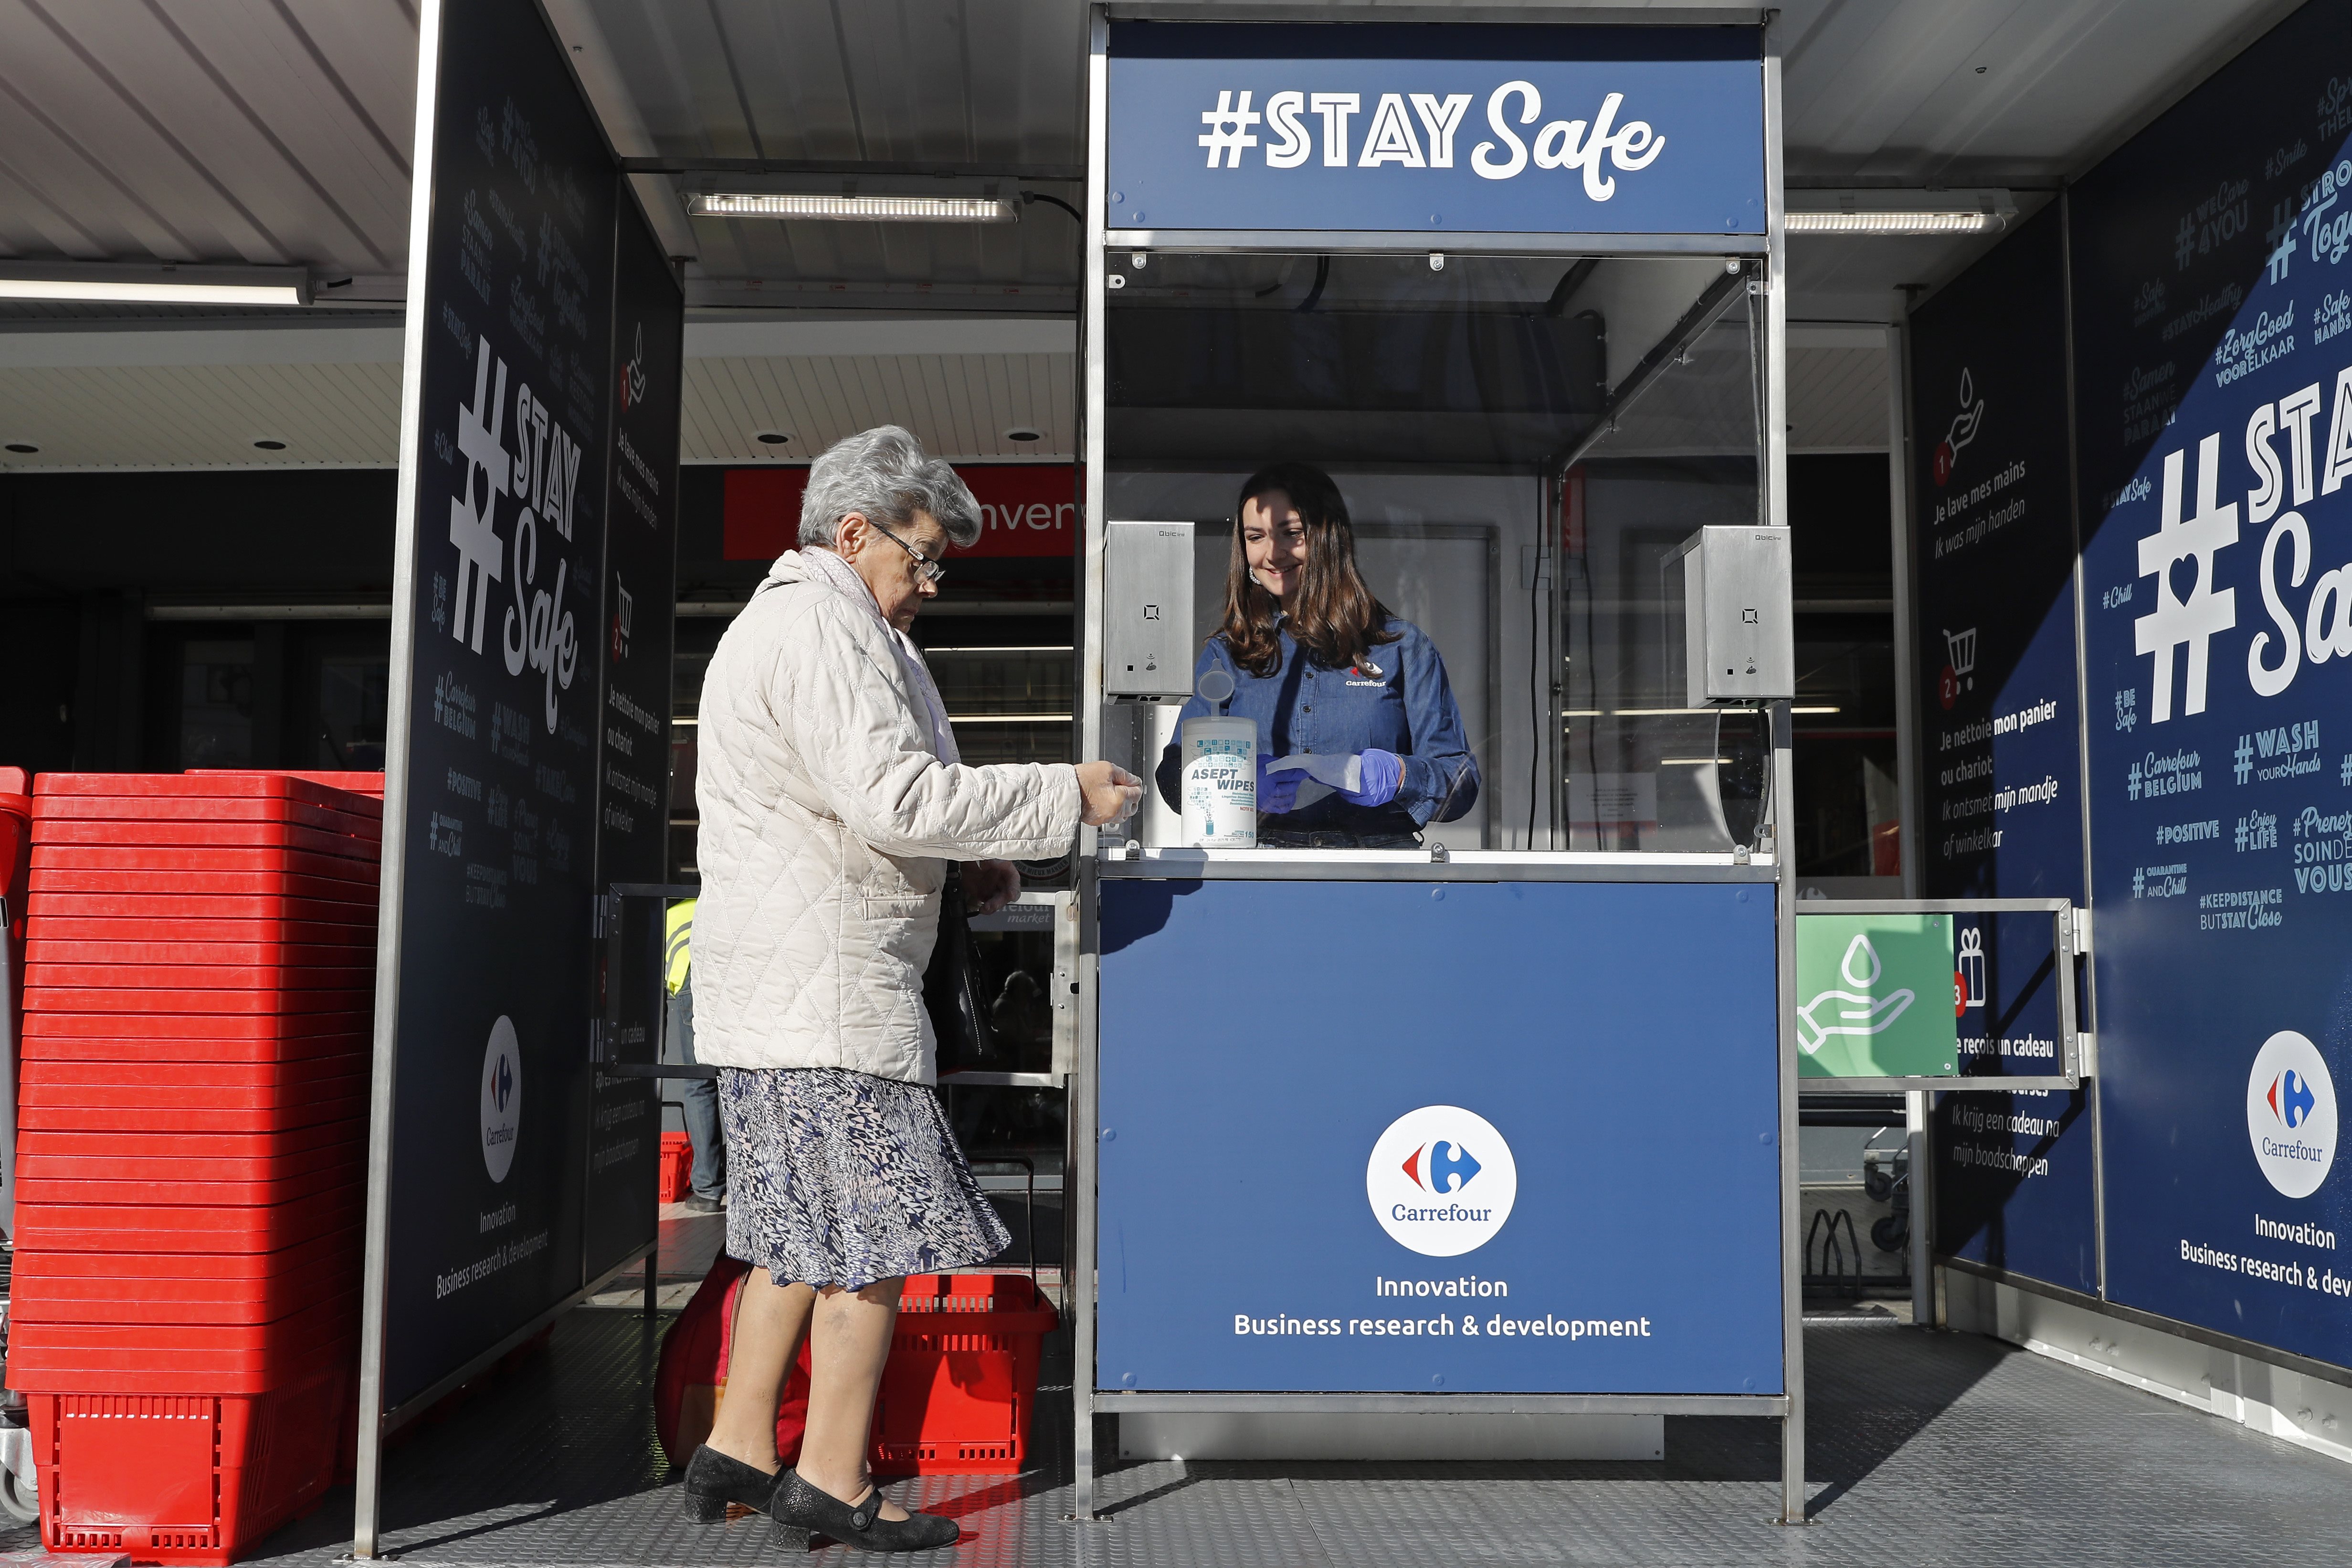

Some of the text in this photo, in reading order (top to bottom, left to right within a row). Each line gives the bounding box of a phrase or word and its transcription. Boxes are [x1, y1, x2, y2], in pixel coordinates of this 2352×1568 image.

[2198, 199, 2247, 254] 4YOU
[2303, 192, 2352, 265] Tog
[2314, 289, 2351, 325] #Safe
[2314, 312, 2352, 346] HANDS
[2215, 335, 2295, 388] VOORELKAAR
[1939, 455, 1944, 474] 1
[1934, 460, 2025, 526] Je lave mes mains
[1935, 498, 2025, 560] Ik was mijn handen
[2103, 583, 2132, 609] #Chill
[2247, 511, 2352, 696] Sa
[504, 507, 578, 734] Safe
[1945, 679, 1951, 699] 2
[2115, 688, 2136, 710] #BE
[444, 705, 476, 740] BELGIUM
[1940, 698, 2057, 752] Je nettoie mon panier
[2116, 707, 2137, 733] Safe
[607, 728, 614, 745] ou
[1192, 768, 1238, 780] ASEPT
[1217, 779, 1255, 792] WIPES
[1941, 755, 1993, 787] ou chariot
[2144, 771, 2202, 798] BELGIUM
[1942, 775, 2058, 821] Ik ontsmet mijn mandje
[1944, 826, 2003, 860] of winkelkar
[2156, 820, 2220, 845] #POSITIVE
[2250, 830, 2278, 850] LIFE
[2294, 863, 2352, 894] VOUS
[2200, 889, 2283, 909] #KEEPDISTANCE
[1007, 913, 1050, 924] market
[1957, 1033, 2054, 1060] e reçois un cadeau
[486, 1123, 514, 1147] Carrefour
[1952, 1104, 2059, 1137] Ik krijg een cadeau na
[1953, 1142, 2048, 1178] mijn boodschappen
[2262, 1137, 2323, 1163] Carrefour
[480, 1201, 516, 1234] Innovation
[1392, 1204, 1492, 1222] Carrefour
[2255, 1213, 2335, 1250] Innovation
[436, 1268, 470, 1300] Business
[471, 1248, 501, 1281] research
[503, 1247, 507, 1265] &
[2181, 1239, 2352, 1297] Business research & dev
[1375, 1276, 1508, 1297] Innovation
[1234, 1314, 1651, 1341] Business research & development
